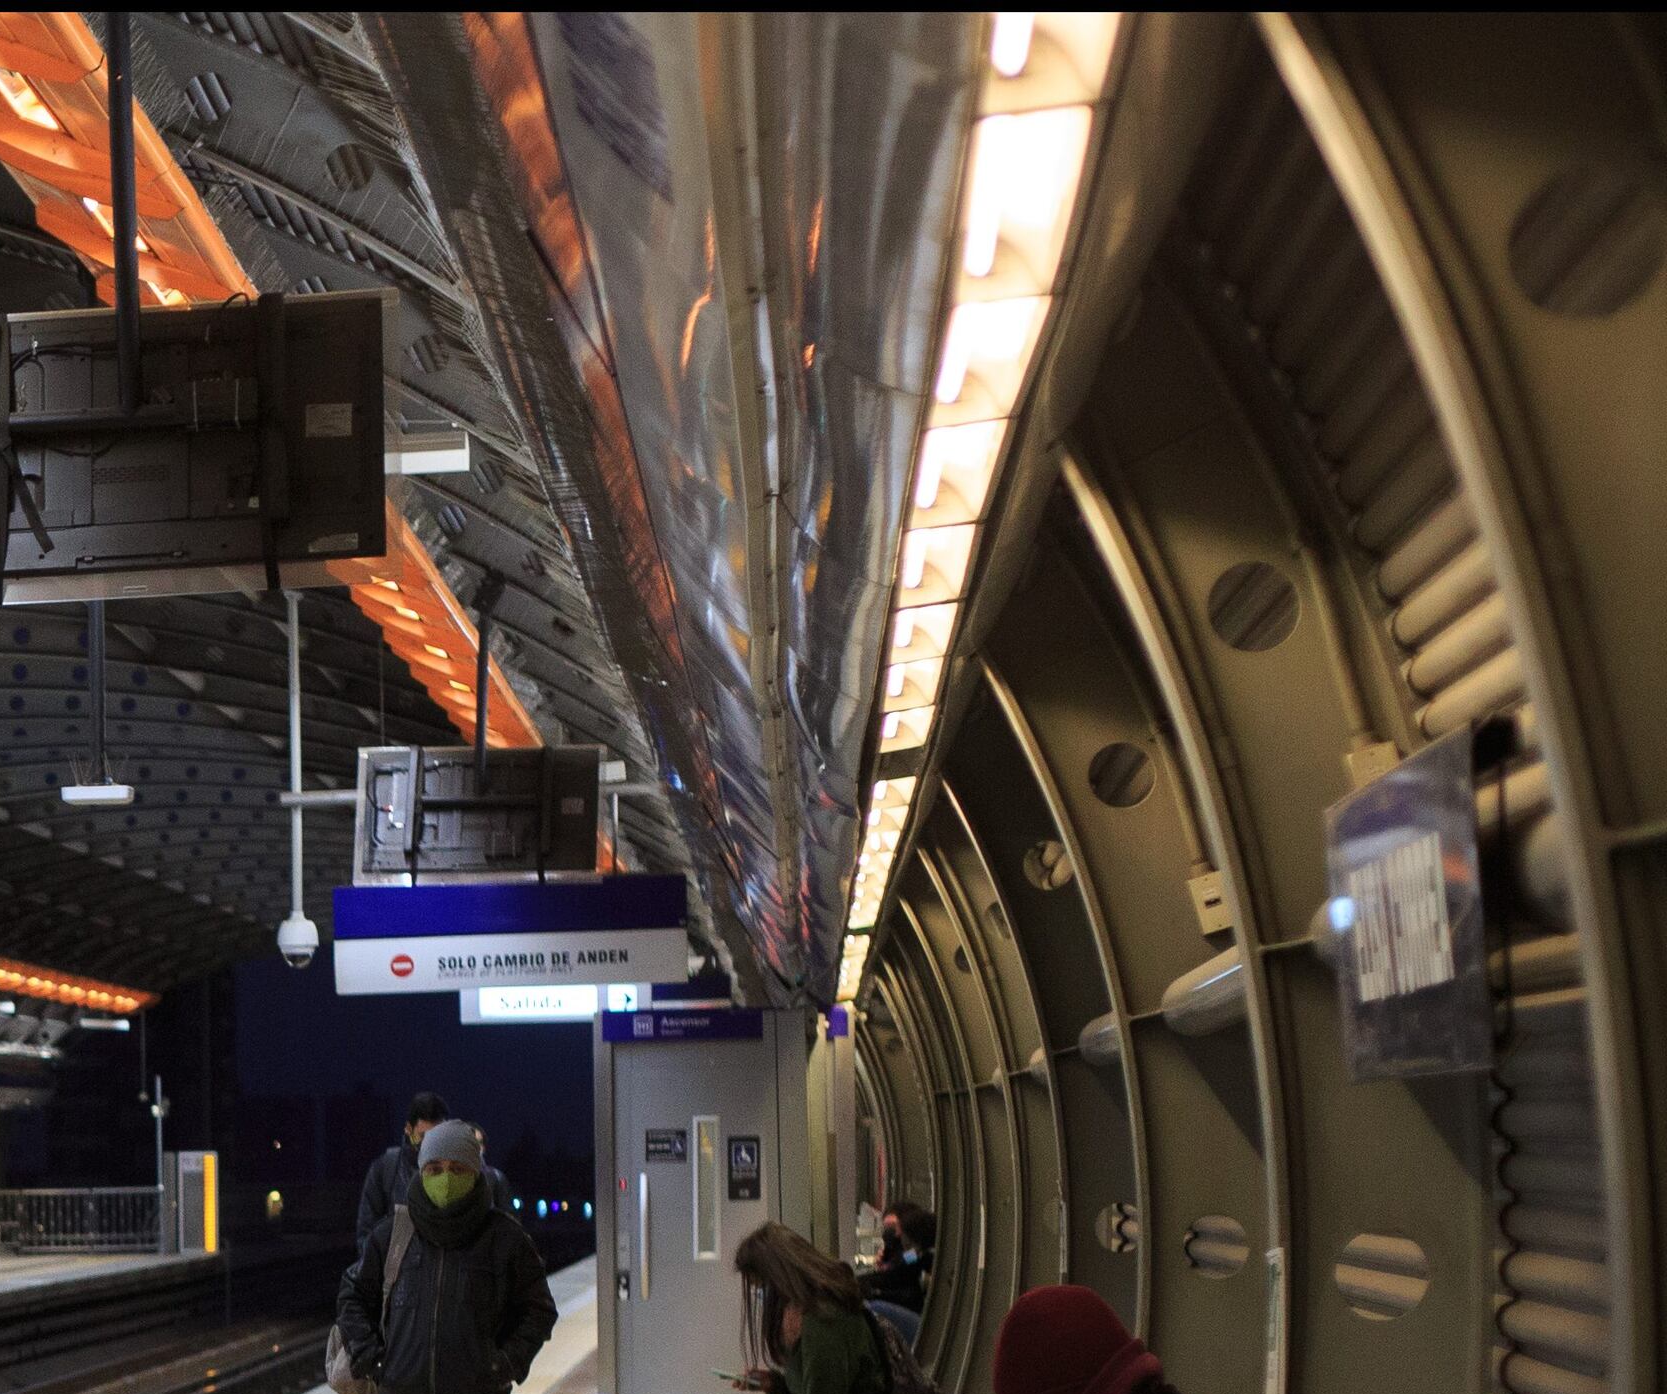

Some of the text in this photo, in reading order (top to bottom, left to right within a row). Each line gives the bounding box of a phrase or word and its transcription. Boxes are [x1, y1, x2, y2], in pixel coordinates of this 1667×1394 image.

[438, 949, 629, 970] SOLO CAMBIO DE ANDEN
